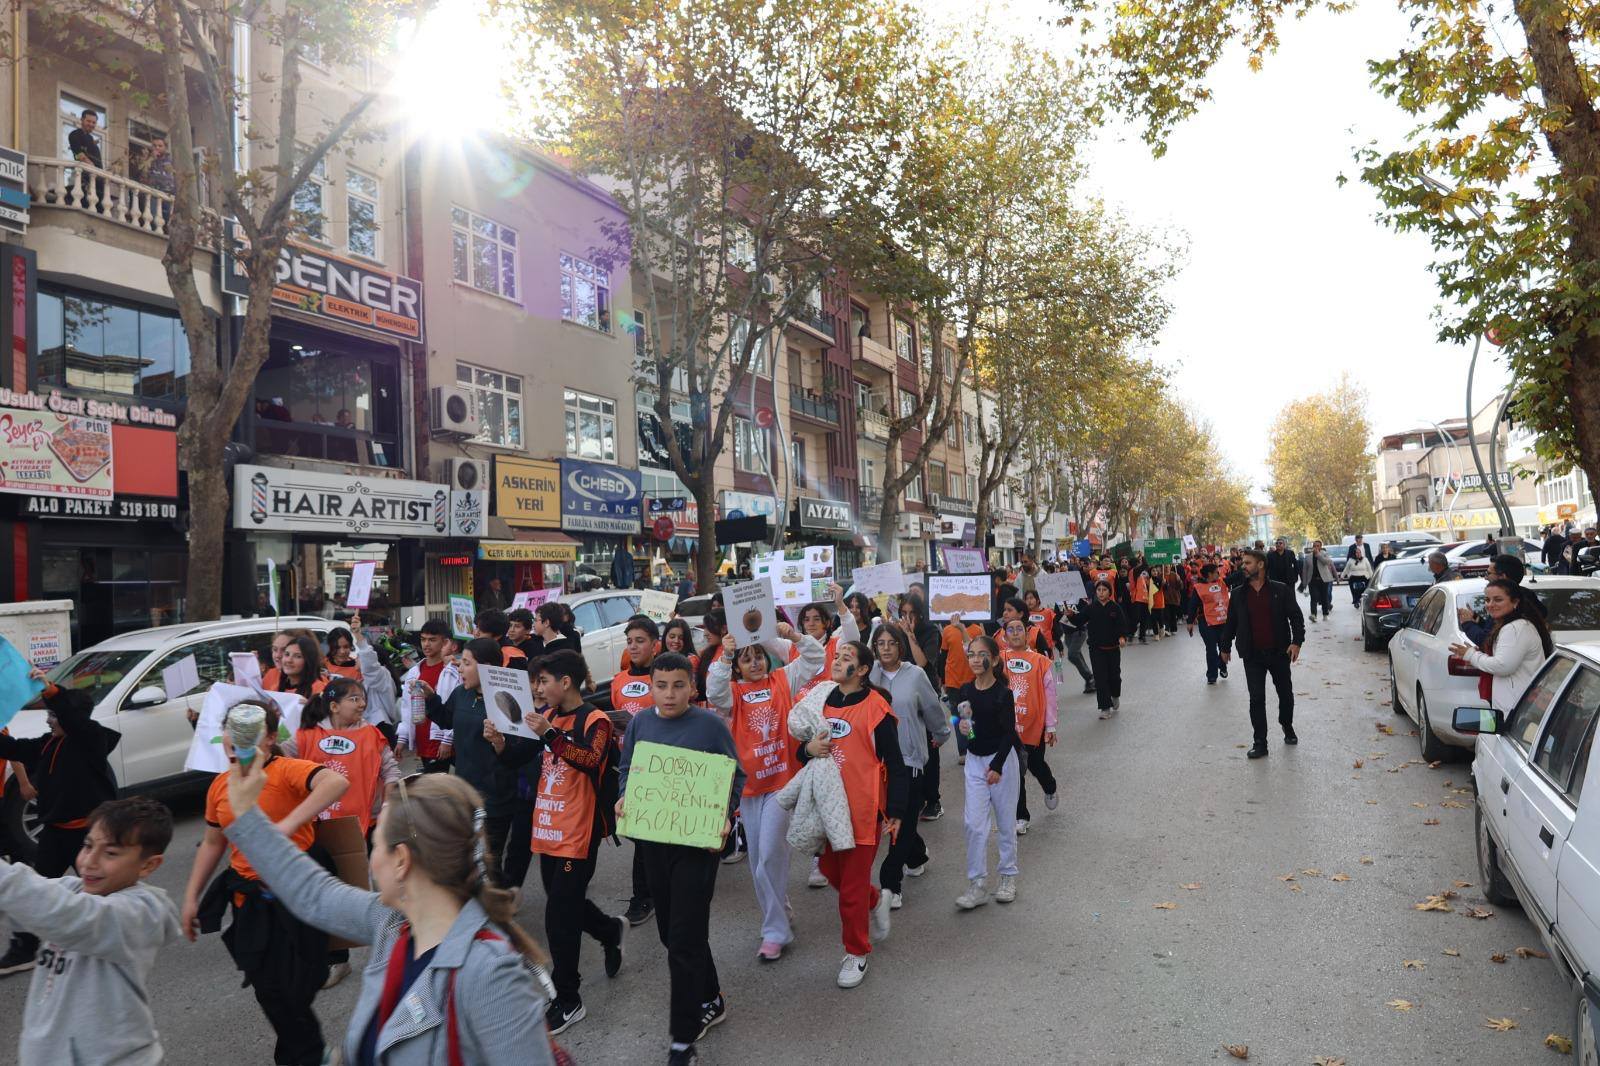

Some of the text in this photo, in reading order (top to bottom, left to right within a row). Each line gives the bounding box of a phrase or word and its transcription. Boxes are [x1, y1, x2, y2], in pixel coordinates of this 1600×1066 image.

[49, 389, 85, 414] Özel
[87, 399, 127, 420] Soslu
[130, 404, 177, 428] Dürüm
[502, 475, 556, 493] ASKERİN
[580, 475, 625, 494] CHESO
[28, 497, 177, 518] ALO PAKET 318 18 00
[273, 490, 432, 521] HAIR ARTIST
[516, 496, 544, 511] YERİ
[807, 503, 849, 521] AYZEM
[661, 776, 696, 793] SEV
